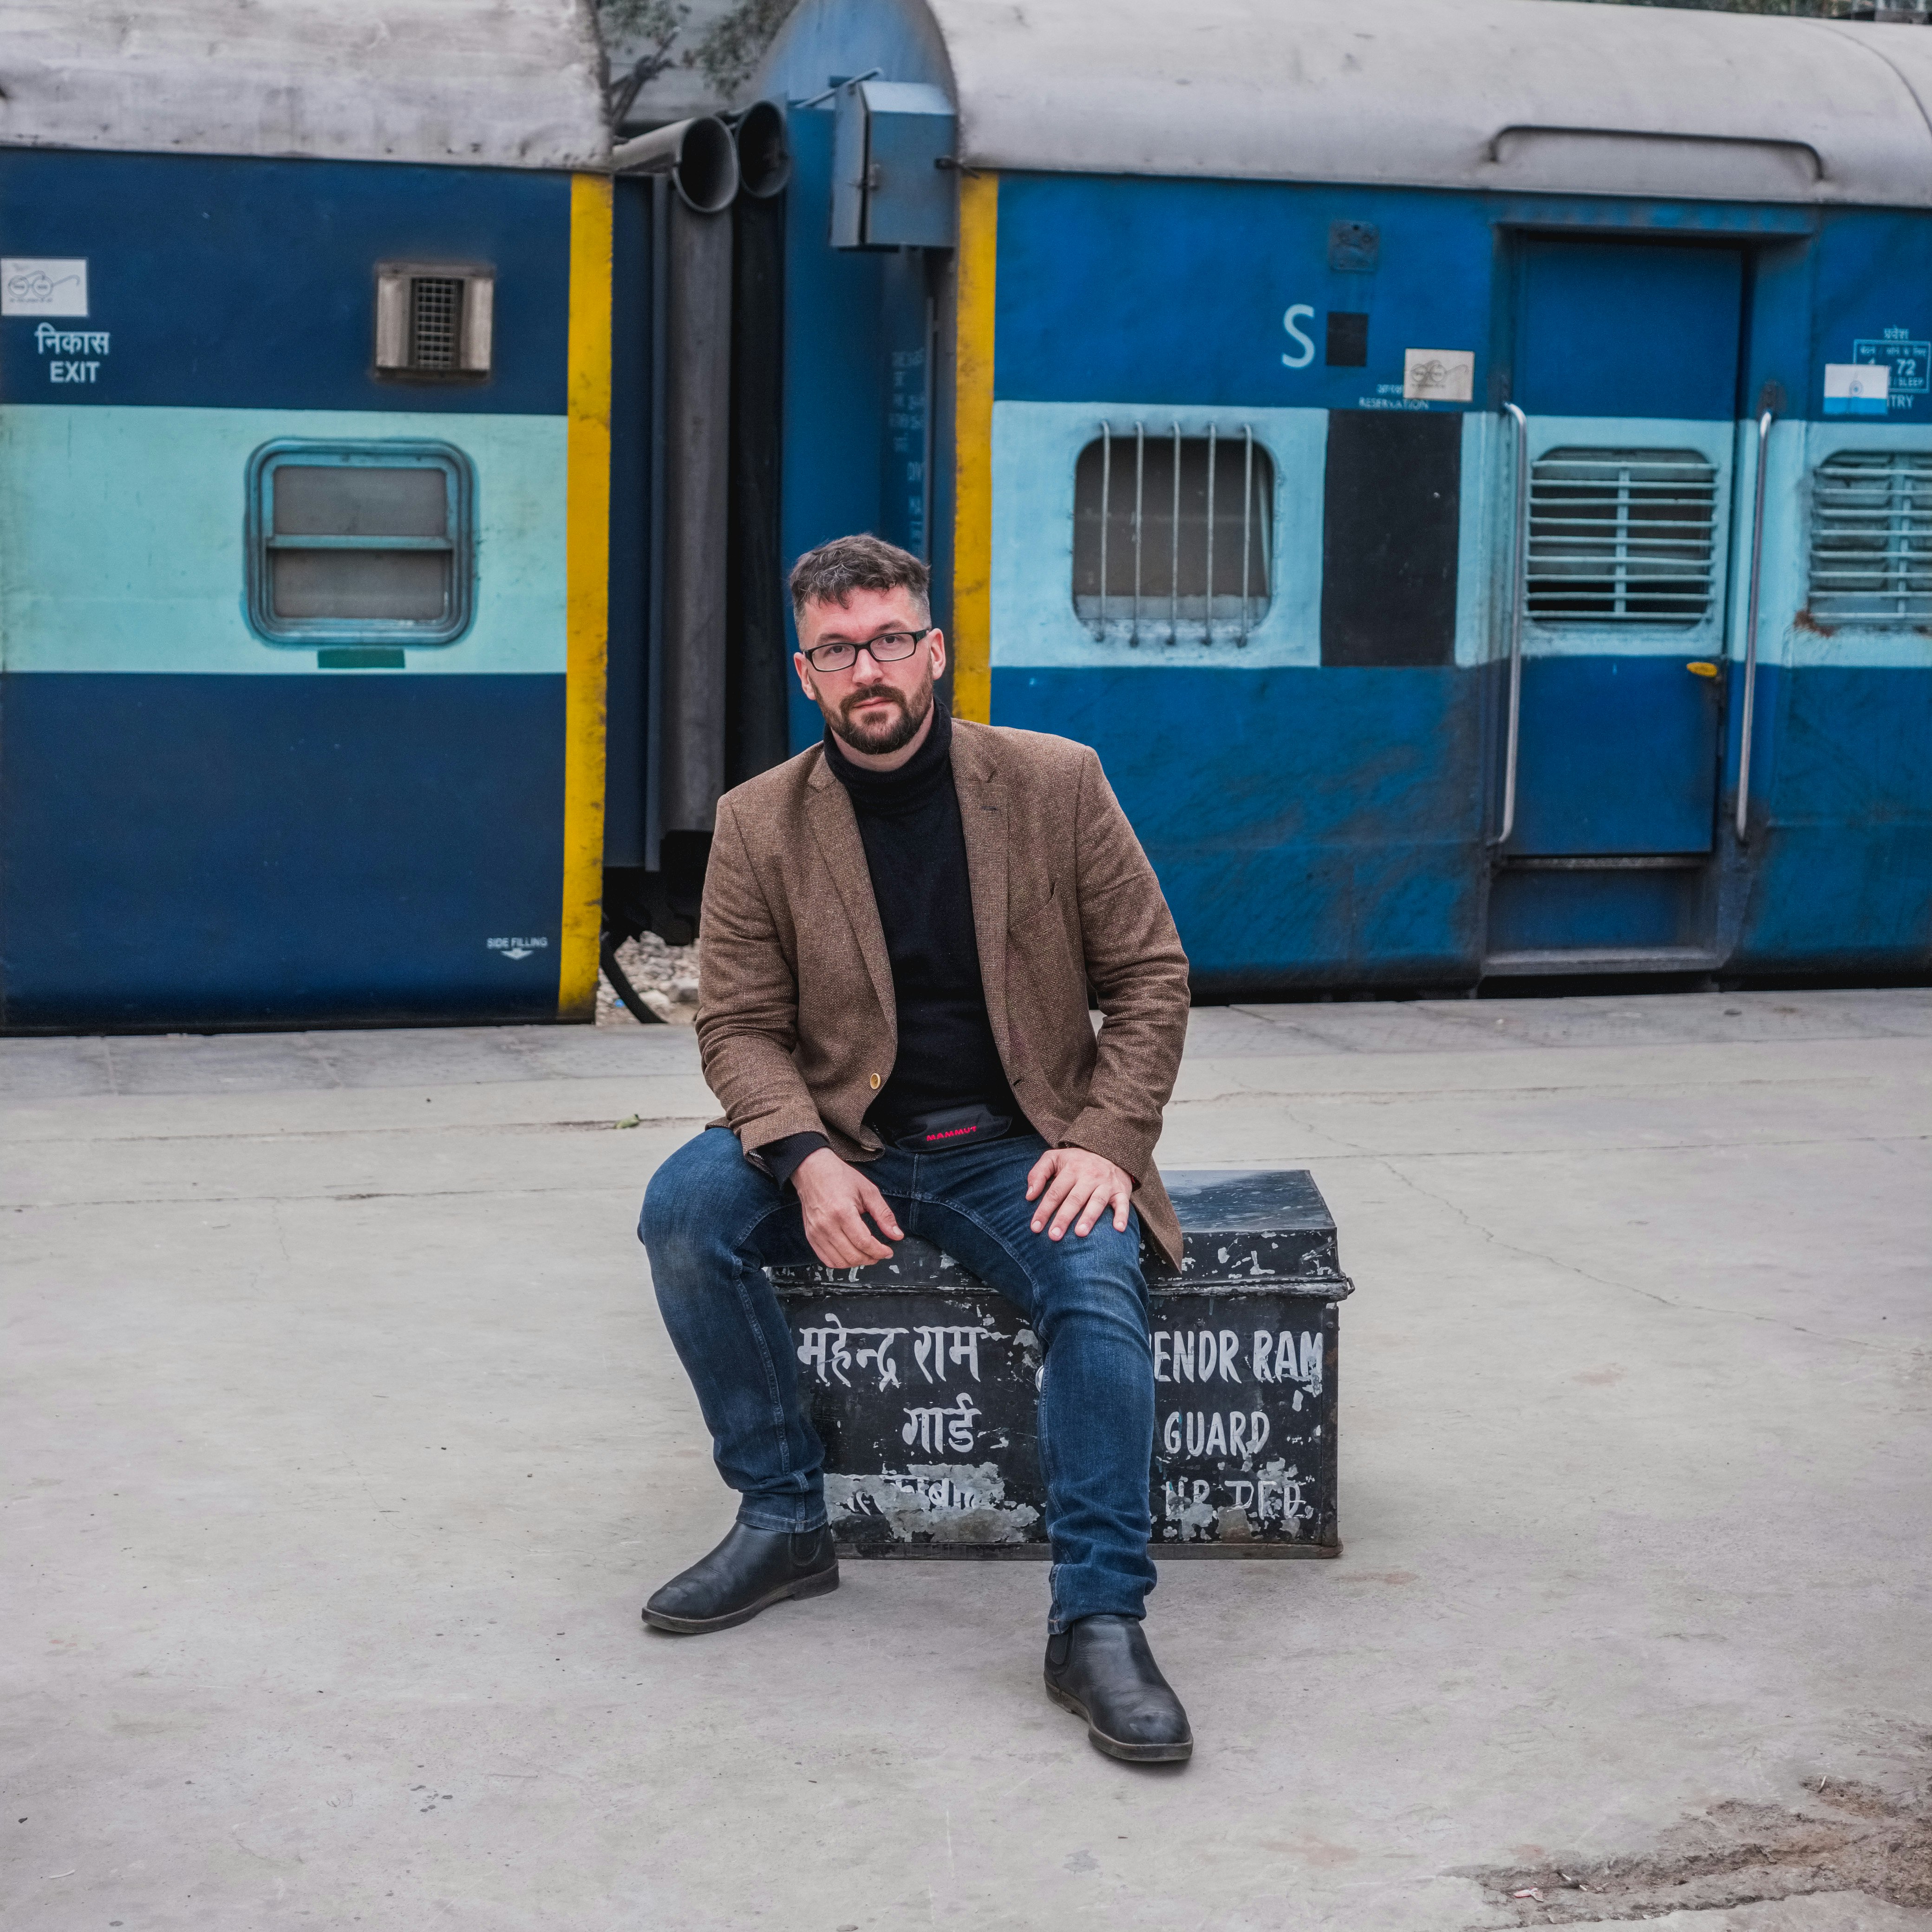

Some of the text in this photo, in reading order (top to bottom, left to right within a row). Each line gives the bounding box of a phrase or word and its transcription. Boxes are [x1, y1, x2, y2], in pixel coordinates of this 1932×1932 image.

[34, 322, 110, 355] निकास
[1281, 303, 1315, 368] S
[50, 360, 100, 383] EXIT
[1896, 358, 1916, 376] 72
[487, 937, 548, 949] SIDE FILLING
[927, 1126, 977, 1142] MAMMUT
[797, 1313, 987, 1391] महेन्द्र राम
[1149, 1330, 1324, 1384] ENDR RAM
[902, 1392, 982, 1454] गार्ड
[1163, 1411, 1270, 1457] GUARD
